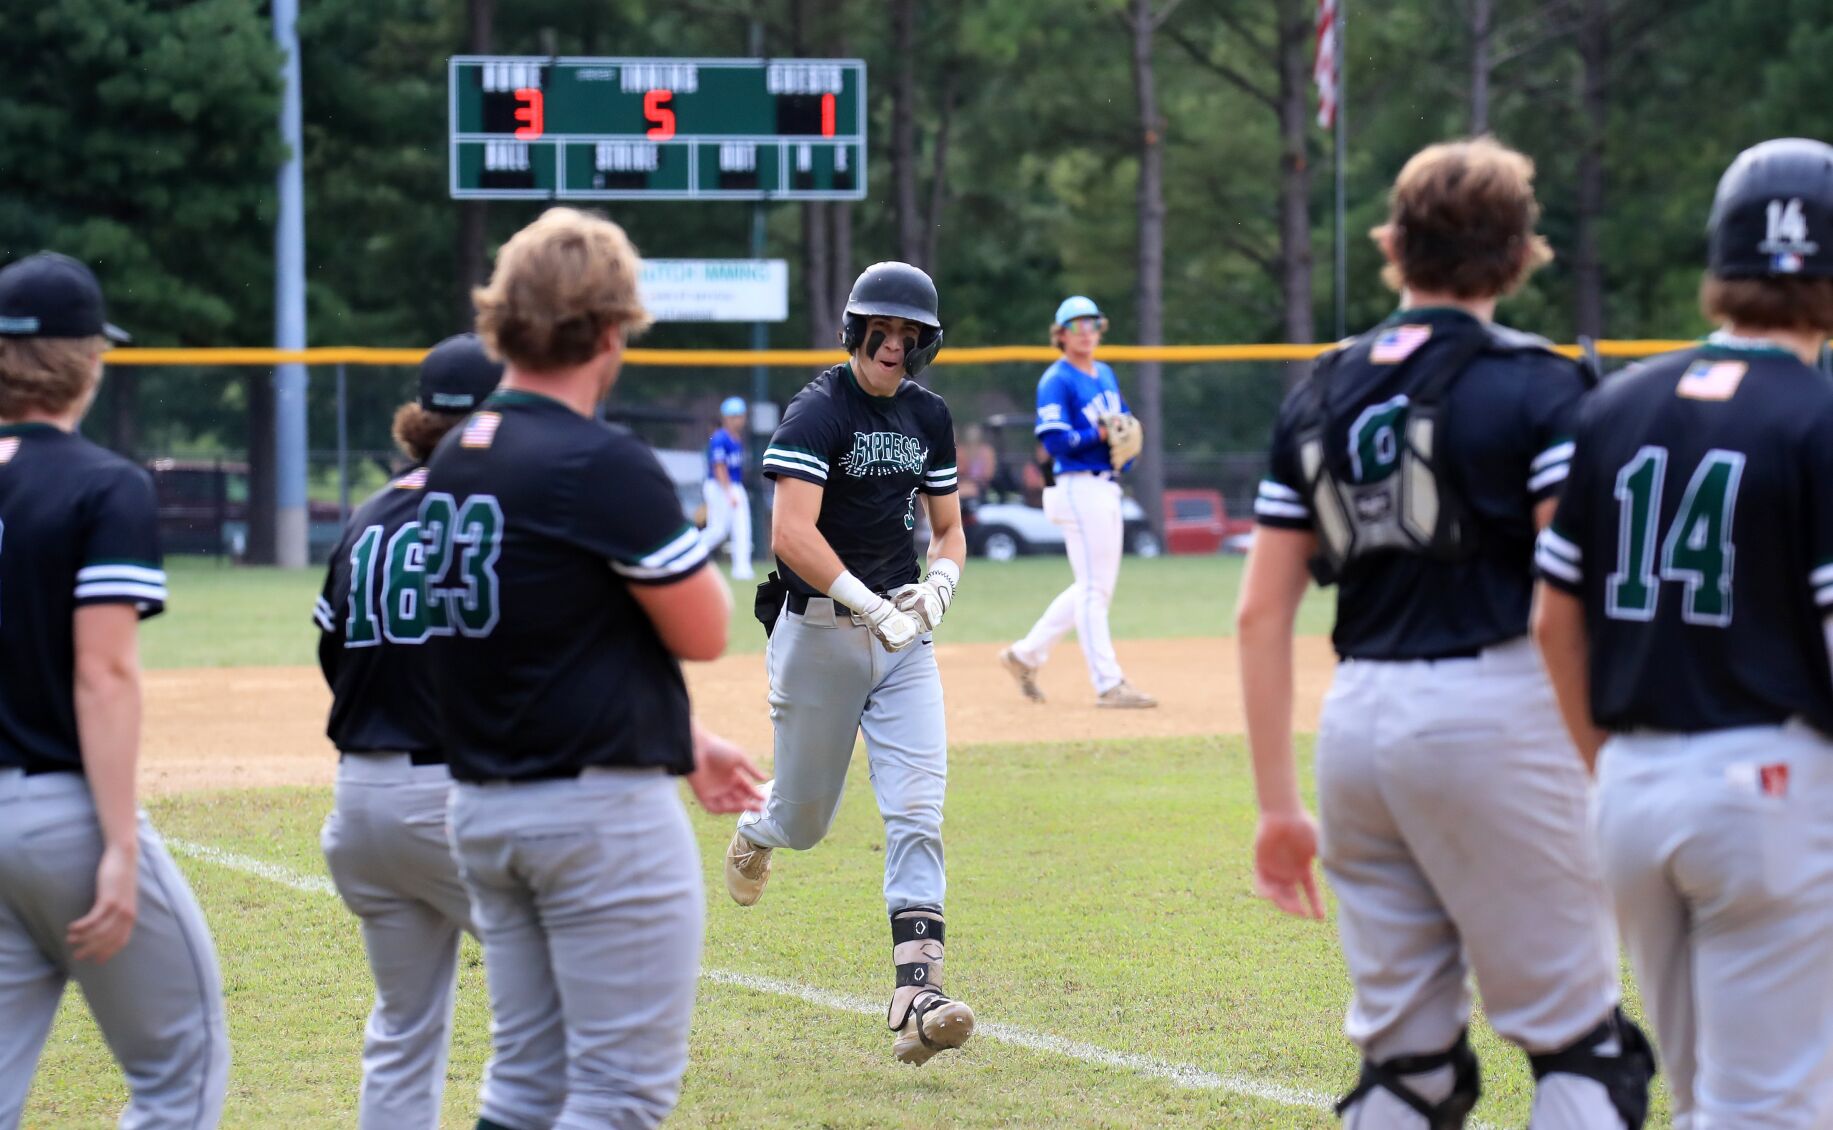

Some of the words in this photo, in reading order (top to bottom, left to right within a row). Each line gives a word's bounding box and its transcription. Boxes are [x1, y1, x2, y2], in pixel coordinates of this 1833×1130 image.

[514, 87, 543, 140] 3
[643, 89, 676, 141] 5
[821, 92, 836, 140] 1
[1765, 198, 1808, 246] 14
[847, 431, 922, 477] EXPRESS
[1605, 446, 1746, 628] 14
[344, 521, 432, 648] 16
[418, 492, 504, 639] 23
